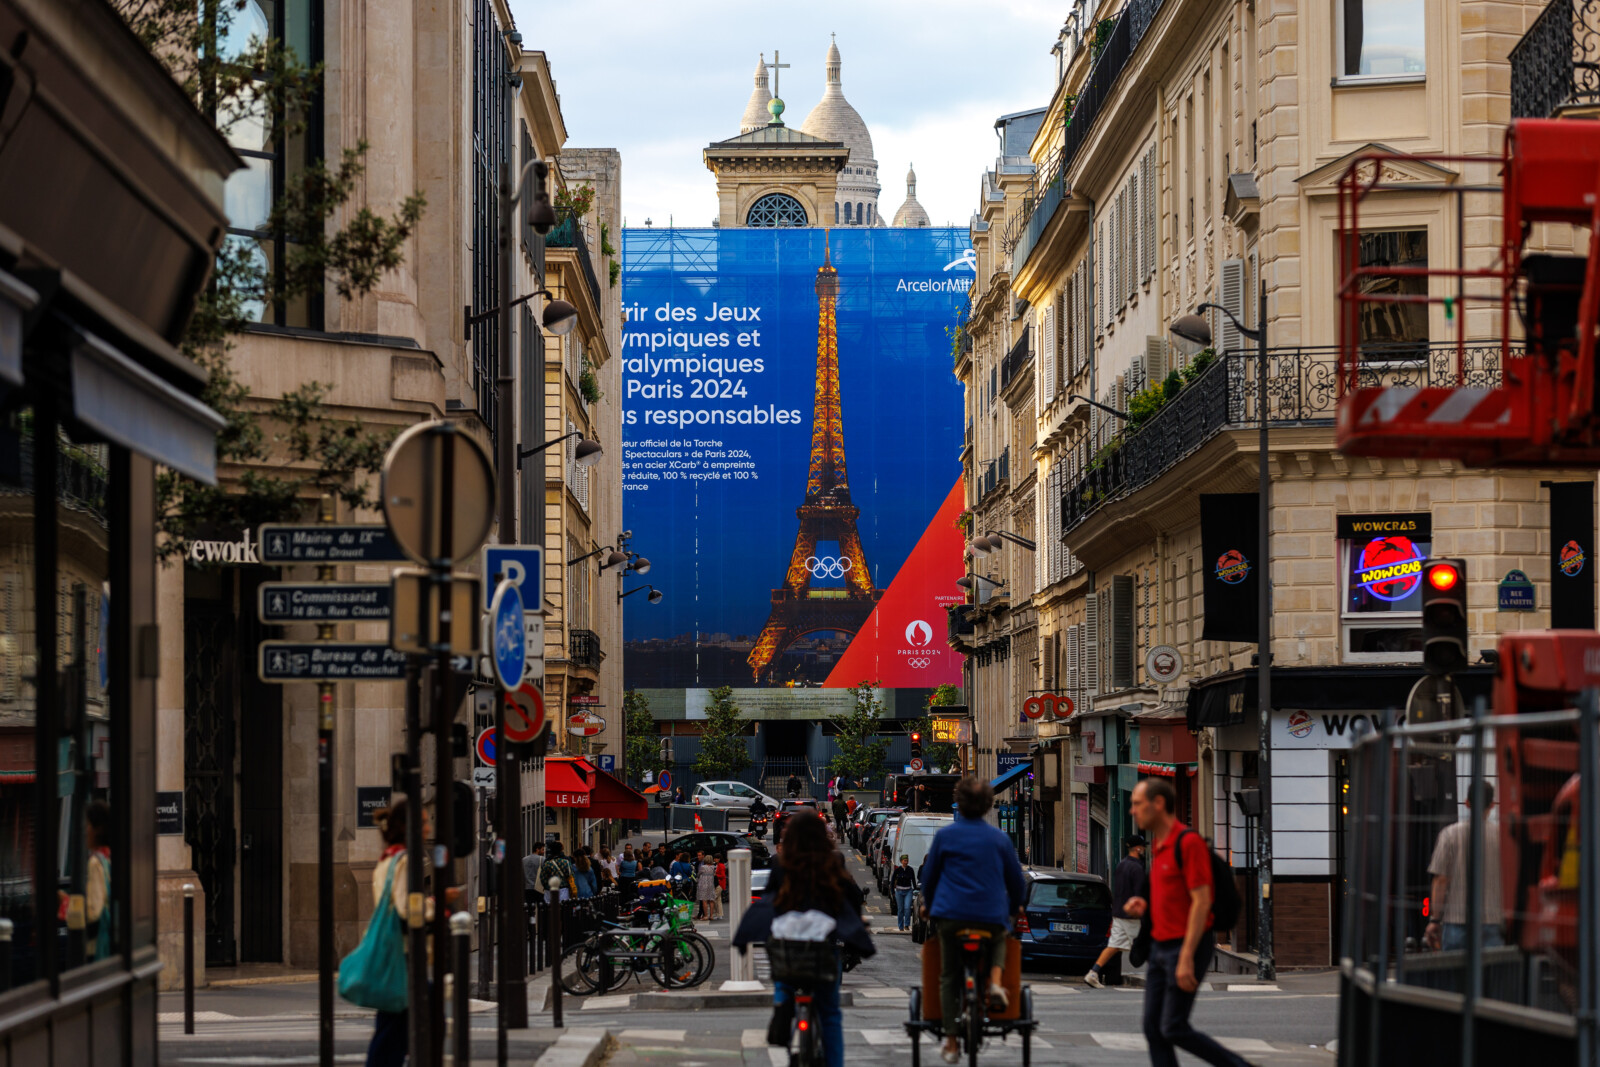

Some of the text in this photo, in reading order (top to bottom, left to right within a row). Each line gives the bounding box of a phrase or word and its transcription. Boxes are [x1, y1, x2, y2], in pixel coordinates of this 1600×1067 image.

[655, 302, 697, 321] des
[704, 302, 761, 321] Jeux
[737, 330, 761, 347] et
[621, 353, 765, 378] ralympiques
[627, 379, 747, 398] Paris 2024
[645, 404, 802, 429] responsables
[640, 439, 668, 447] officiel
[670, 439, 681, 447] de
[683, 439, 692, 447] la
[693, 439, 723, 447] Torche
[625, 450, 682, 460] Spectaculars
[691, 450, 703, 458] de
[705, 450, 726, 458] Paris
[727, 450, 751, 459] 2024,
[645, 461, 667, 469] acier
[711, 461, 755, 470] empreinte
[627, 471, 661, 480] réduite,
[662, 471, 678, 479] 100
[680, 471, 687, 479] %
[690, 471, 720, 481] recyclé
[733, 471, 749, 479] 100
[751, 471, 759, 479] %
[1352, 521, 1417, 532] WOWCRAB
[292, 531, 333, 544] Mairie
[338, 531, 354, 543] du
[305, 547, 326, 558] Rue
[1361, 560, 1422, 583] WOWCRAB
[292, 590, 378, 604] Commissariat
[328, 606, 348, 616] Rue
[311, 649, 355, 662] Bureau
[361, 649, 378, 661] de
[328, 664, 348, 675] Rue
[602, 756, 612, 768] P
[998, 757, 1020, 765] JUST
[556, 794, 568, 804] LE
